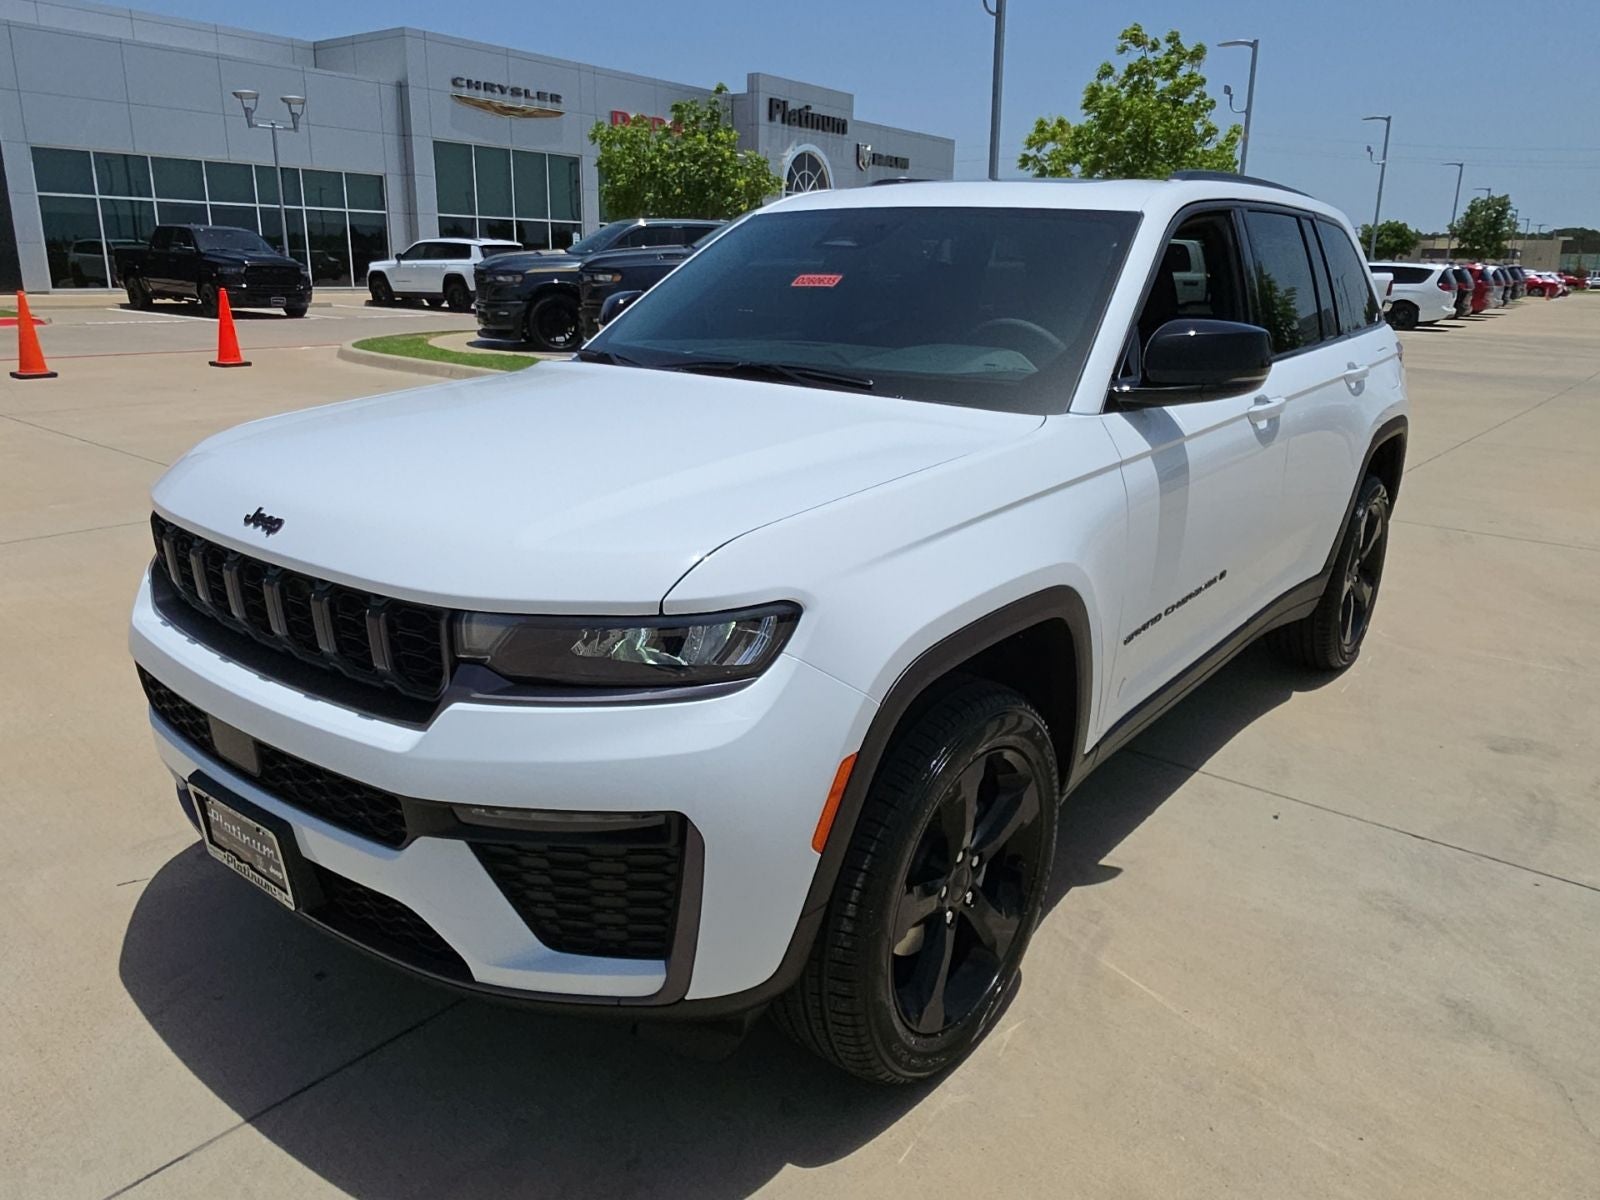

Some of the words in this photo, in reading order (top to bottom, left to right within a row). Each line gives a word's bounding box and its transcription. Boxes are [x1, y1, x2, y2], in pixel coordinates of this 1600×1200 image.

[451, 77, 562, 104] CHRYSLER
[768, 97, 848, 135] Platinum
[243, 506, 285, 538] Jeep
[1123, 612, 1162, 646] GRAND
[207, 807, 275, 859] Platinum
[223, 852, 277, 893] Platinum
